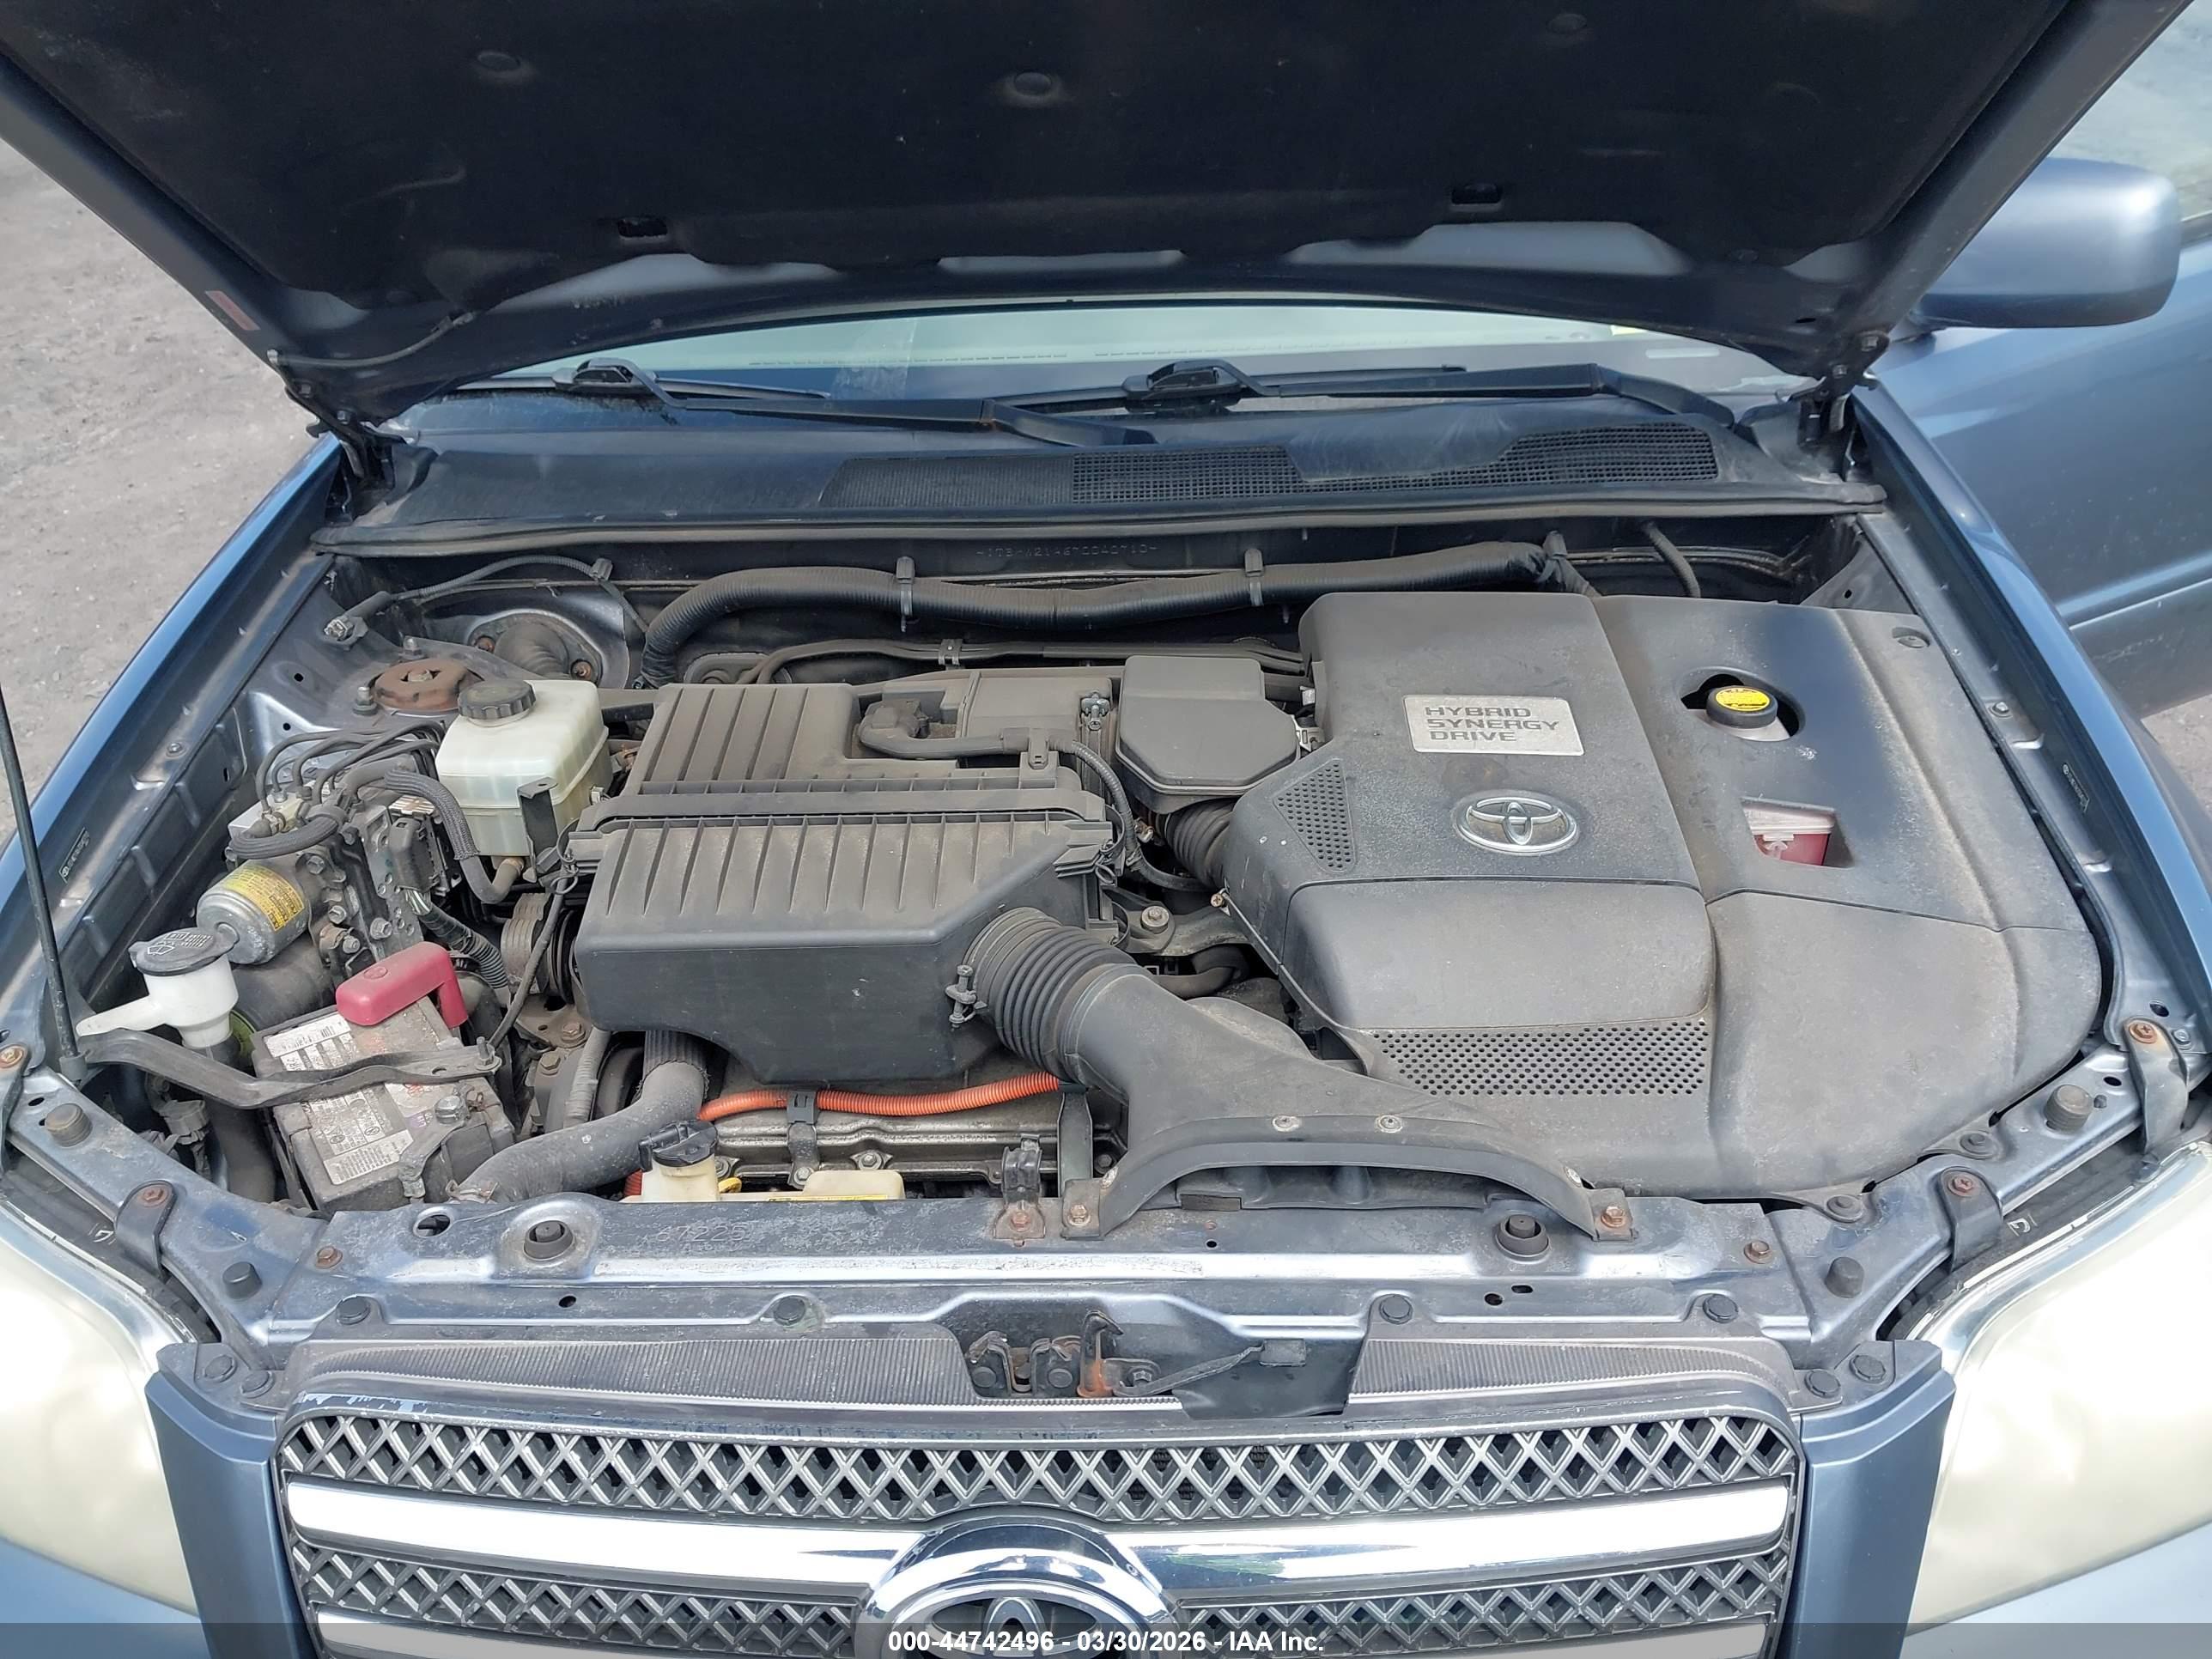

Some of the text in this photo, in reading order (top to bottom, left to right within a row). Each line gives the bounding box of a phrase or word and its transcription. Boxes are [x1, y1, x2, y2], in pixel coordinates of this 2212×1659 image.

[1425, 707, 1531, 717] HYBRID
[1426, 719, 1559, 730] SYNERGY
[1429, 731, 1516, 741] DRIVE
